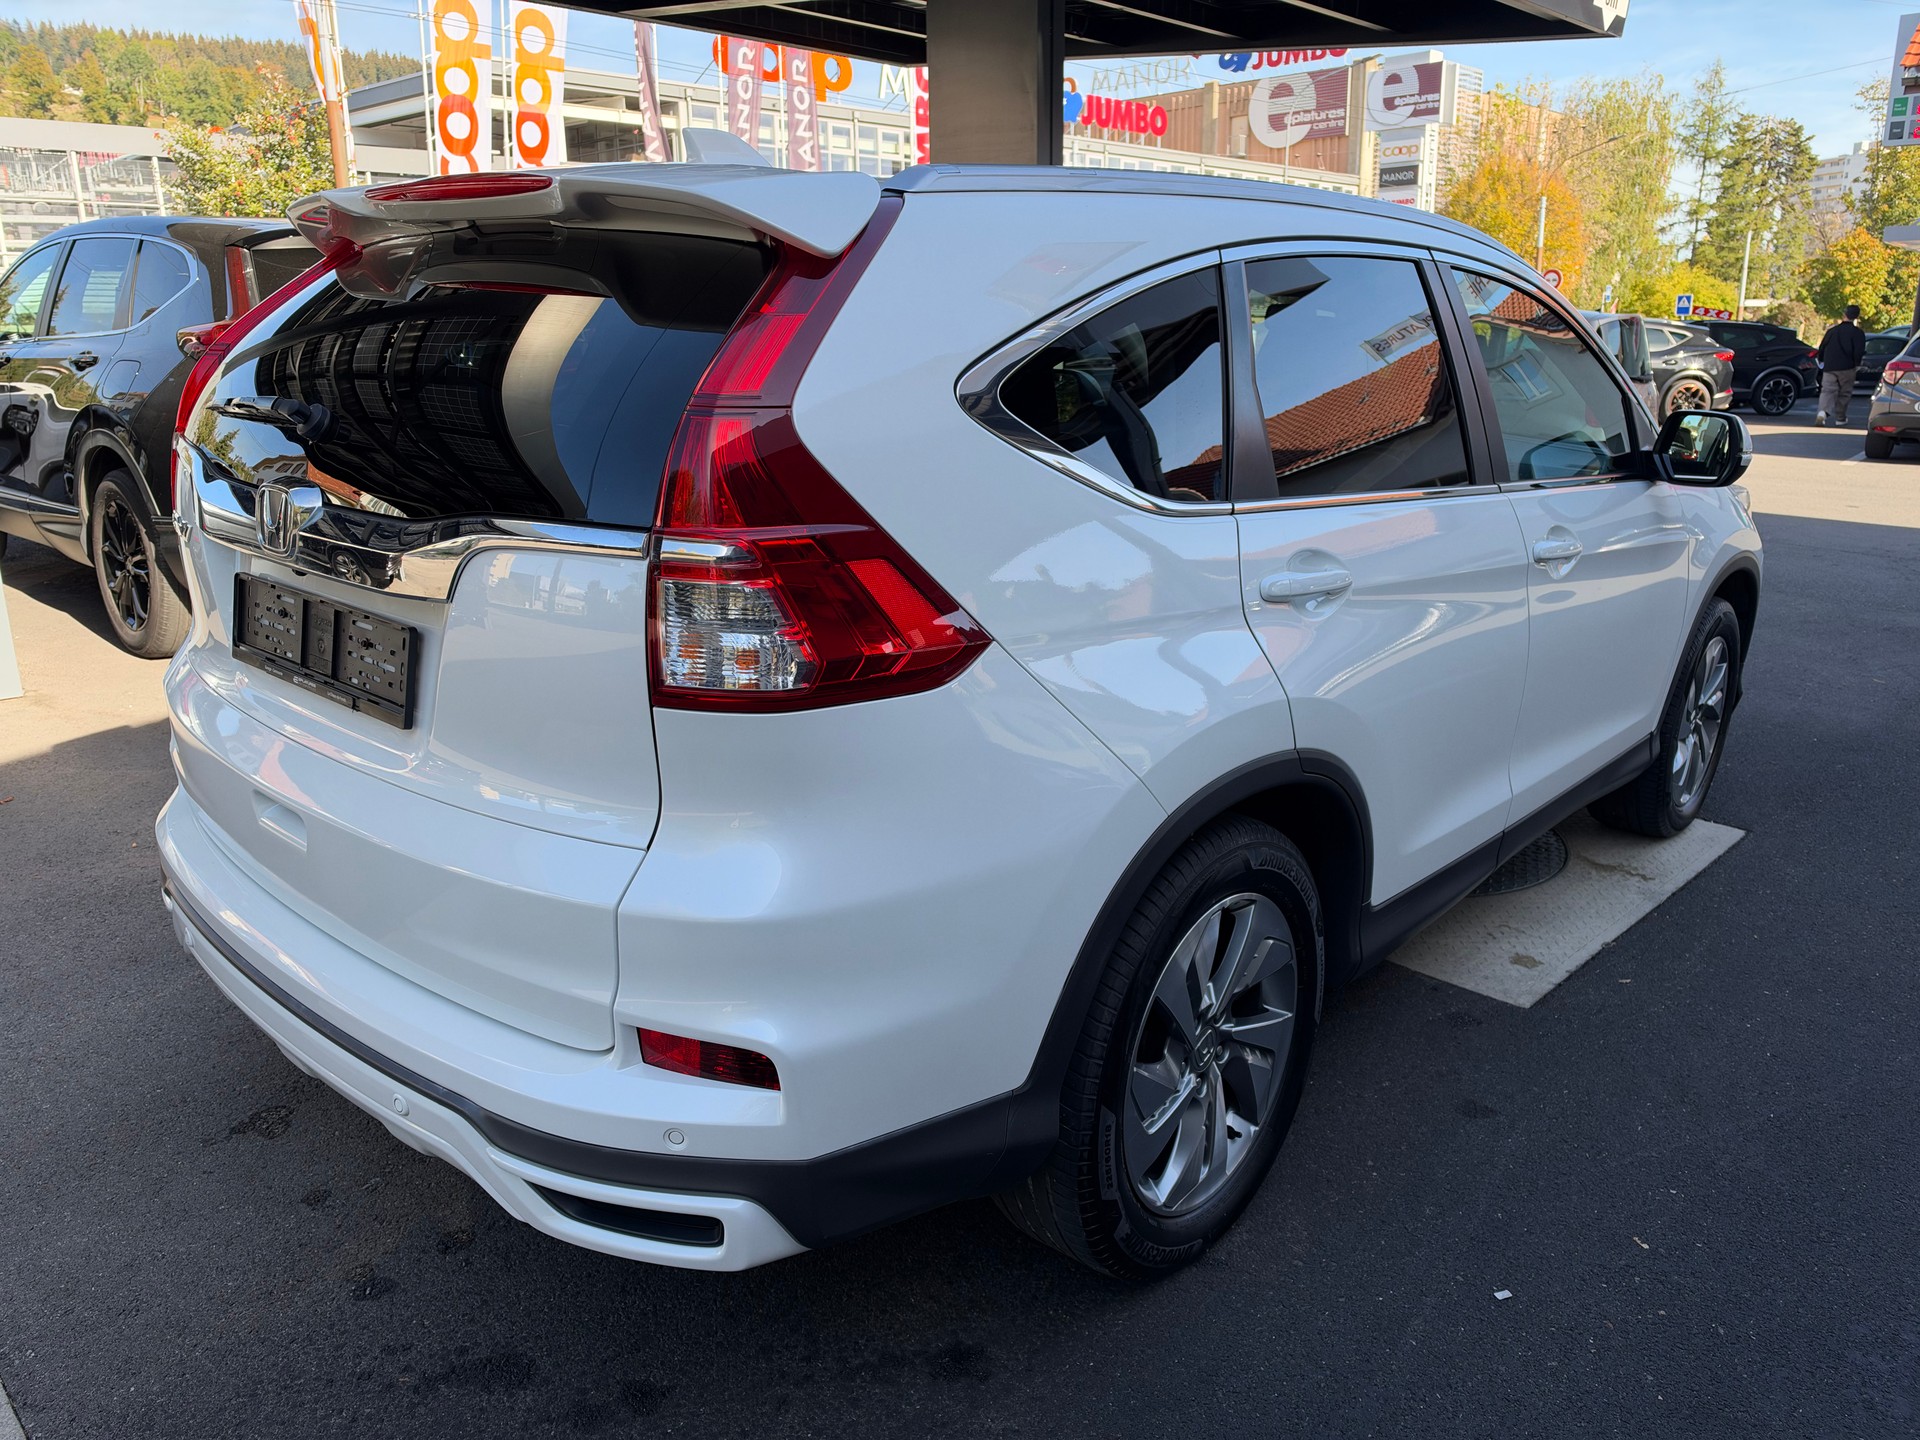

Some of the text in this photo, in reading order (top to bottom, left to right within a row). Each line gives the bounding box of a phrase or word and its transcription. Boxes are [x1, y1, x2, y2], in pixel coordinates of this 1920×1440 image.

[515, 8, 565, 168] oop
[792, 58, 817, 171] ANOR
[1081, 94, 1168, 137] JUMBO
[1382, 144, 1420, 158] coop
[1381, 170, 1416, 182] MANOR
